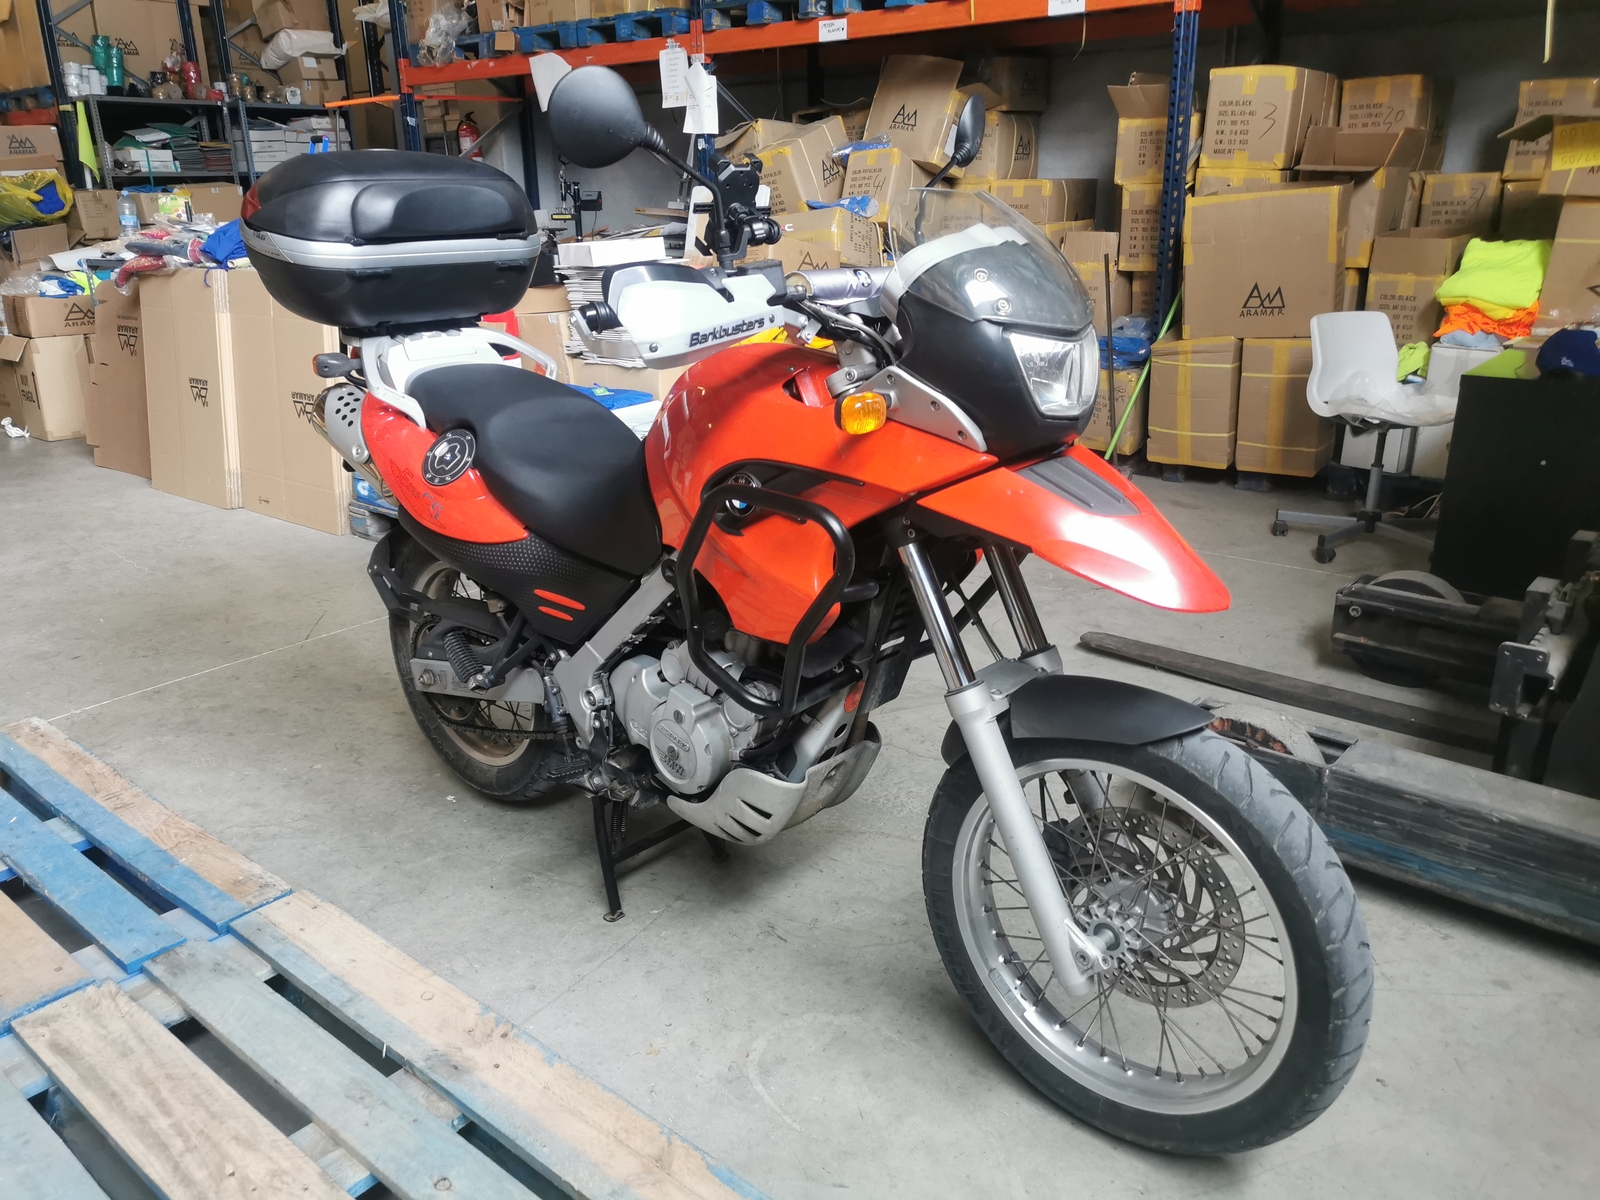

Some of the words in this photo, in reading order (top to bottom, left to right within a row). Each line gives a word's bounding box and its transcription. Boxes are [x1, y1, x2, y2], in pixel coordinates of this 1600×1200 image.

[888, 124, 916, 132] ARAMAR
[1239, 308, 1286, 318] ARAMAR
[64, 320, 96, 328] ARAM
[117, 324, 138, 334] ARAMAR
[689, 317, 765, 348] Barkbusters
[189, 377, 208, 387] ARAMAR
[291, 391, 315, 402] ARAMAR
